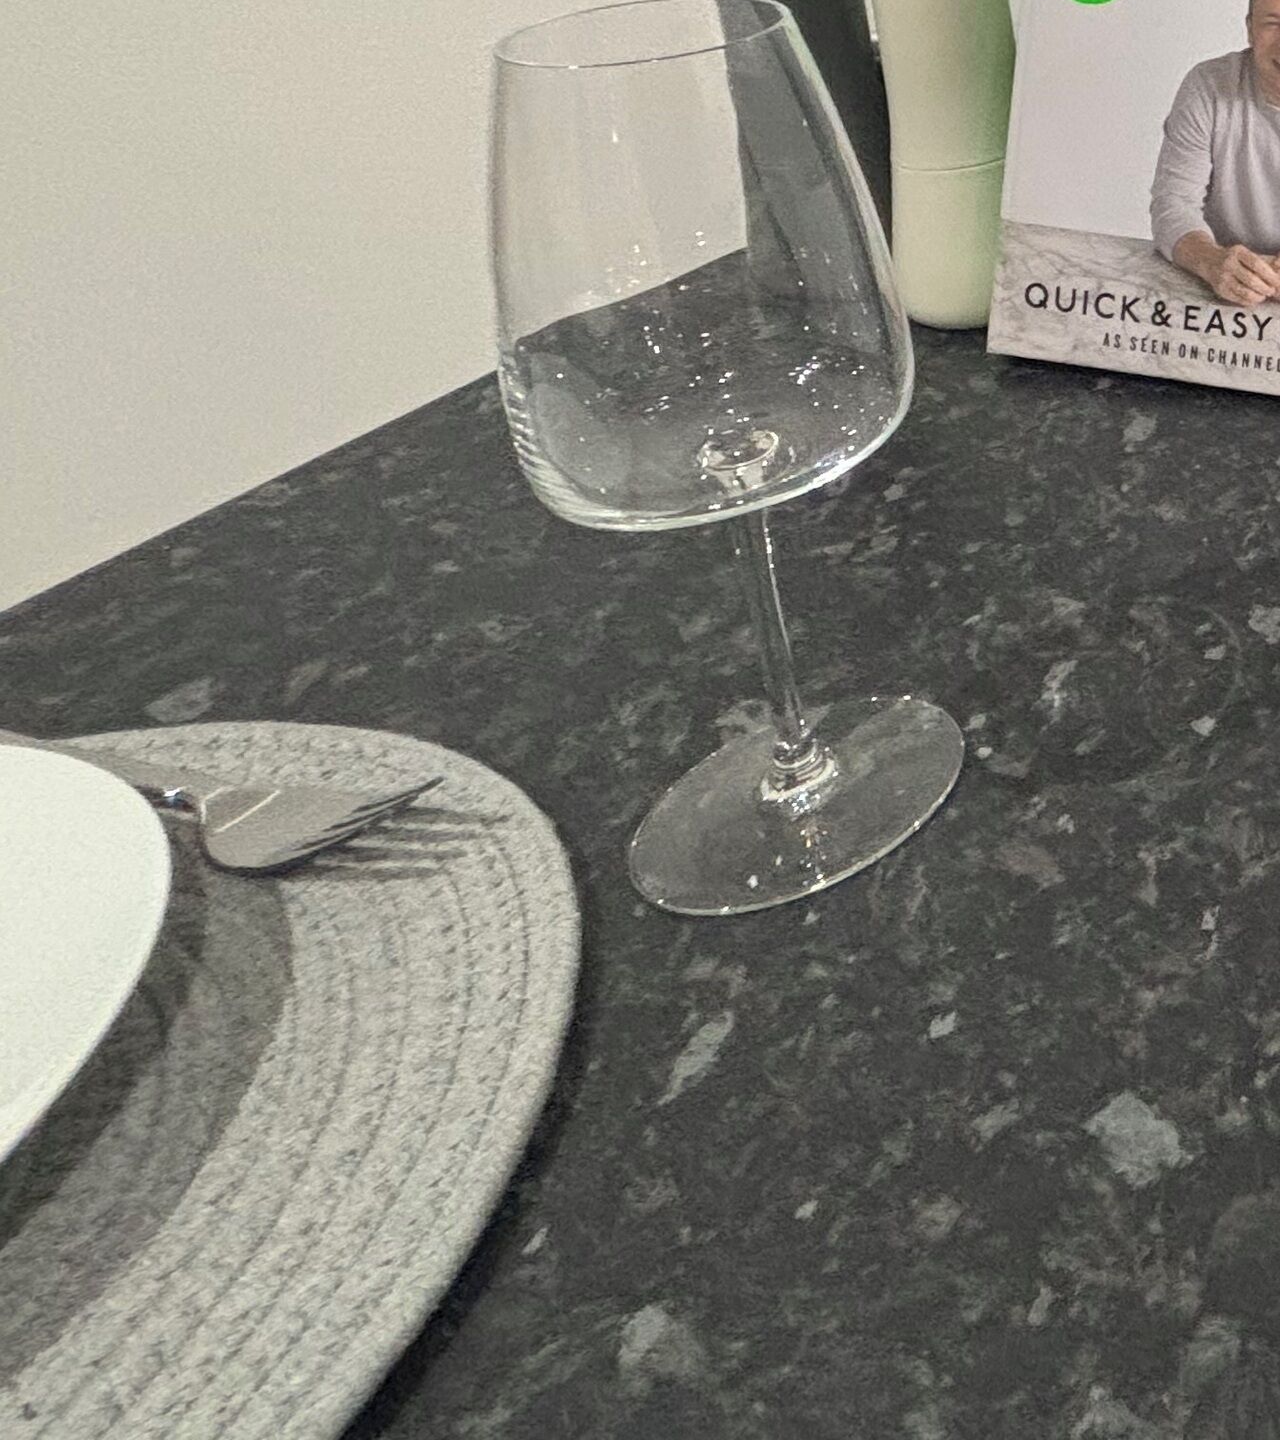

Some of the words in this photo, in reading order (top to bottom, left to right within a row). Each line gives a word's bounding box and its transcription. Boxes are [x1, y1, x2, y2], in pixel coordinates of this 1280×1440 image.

[1024, 282, 1140, 324] QUICK
[1150, 300, 1172, 328] &
[1183, 305, 1273, 342] EASY
[1102, 332, 1122, 349] AS
[1129, 336, 1171, 356] SEEN
[1178, 343, 1199, 360] ON
